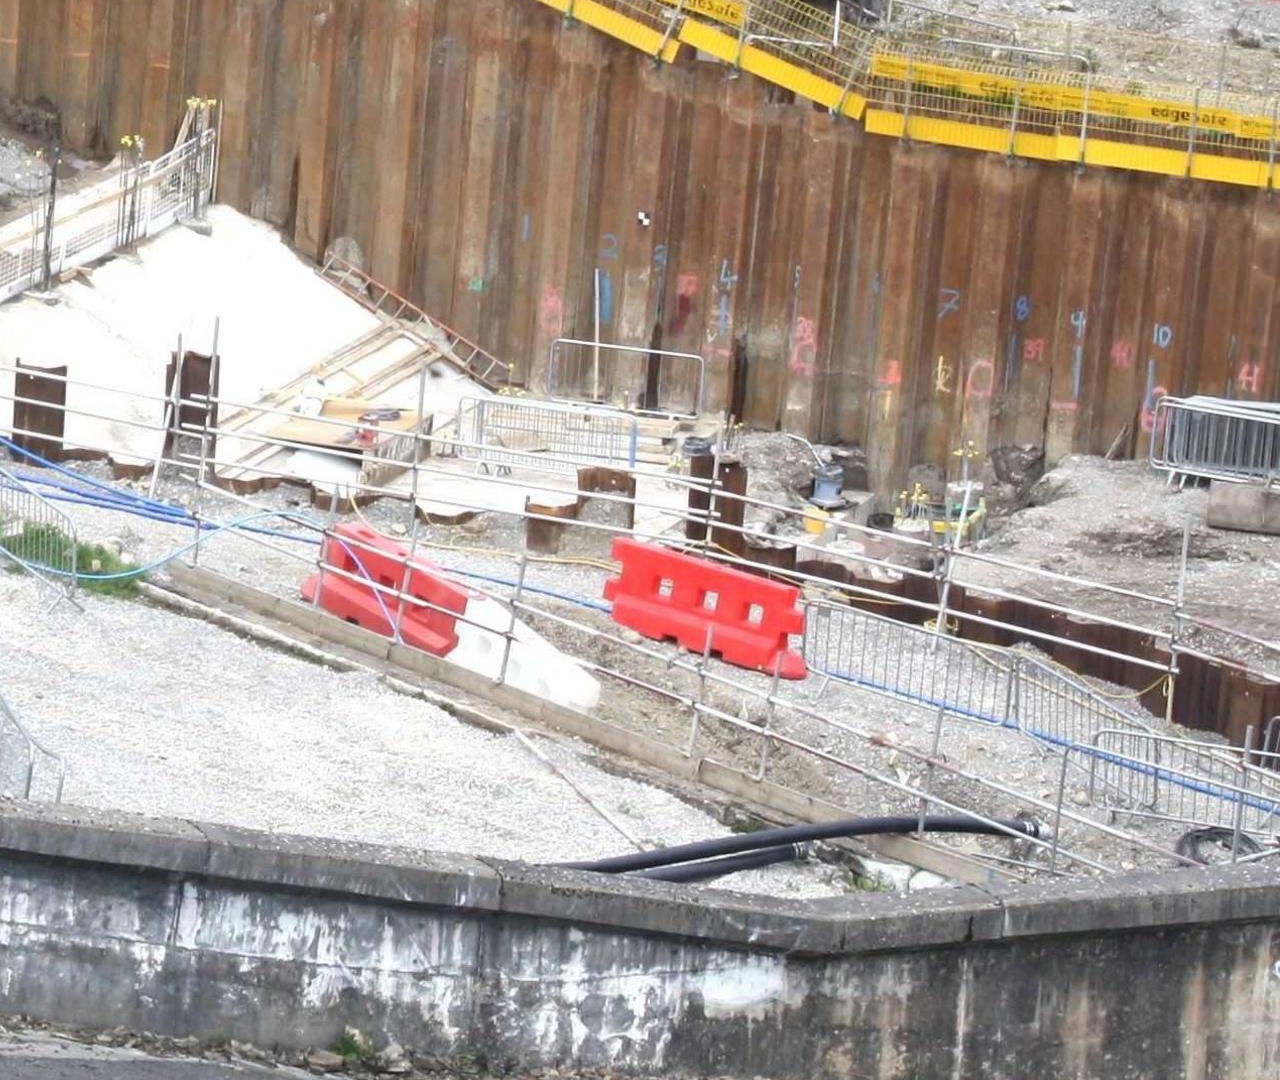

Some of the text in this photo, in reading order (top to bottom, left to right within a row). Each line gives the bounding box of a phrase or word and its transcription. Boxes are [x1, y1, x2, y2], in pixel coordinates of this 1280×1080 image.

[719, 258, 738, 291] 4
[938, 287, 960, 319] 7
[1015, 295, 1030, 321] 8
[1070, 308, 1086, 338] 9
[1152, 322, 1172, 349] 10
